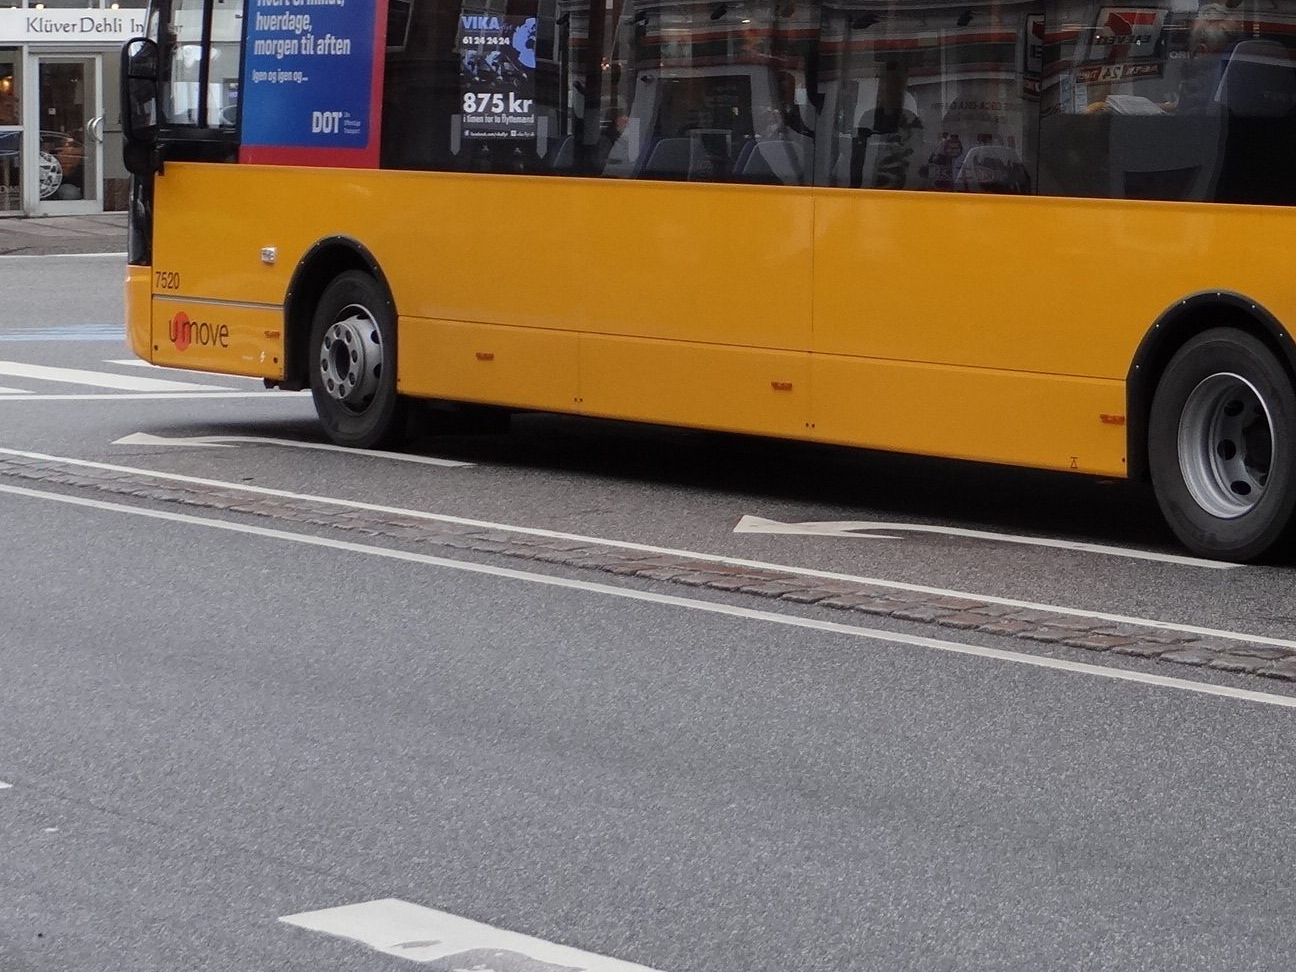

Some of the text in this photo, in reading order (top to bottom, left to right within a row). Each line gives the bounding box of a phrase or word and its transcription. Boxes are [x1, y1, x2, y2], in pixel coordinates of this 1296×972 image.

[26, 16, 78, 33] Klüver
[79, 16, 123, 33] Dehli
[255, 11, 313, 35] hverdage,
[461, 15, 500, 29] VIKA
[254, 33, 351, 59] morgen til aften
[462, 36, 510, 45] 61 24 24 24
[463, 91, 533, 114] 875 kr
[155, 271, 180, 290] 7520
